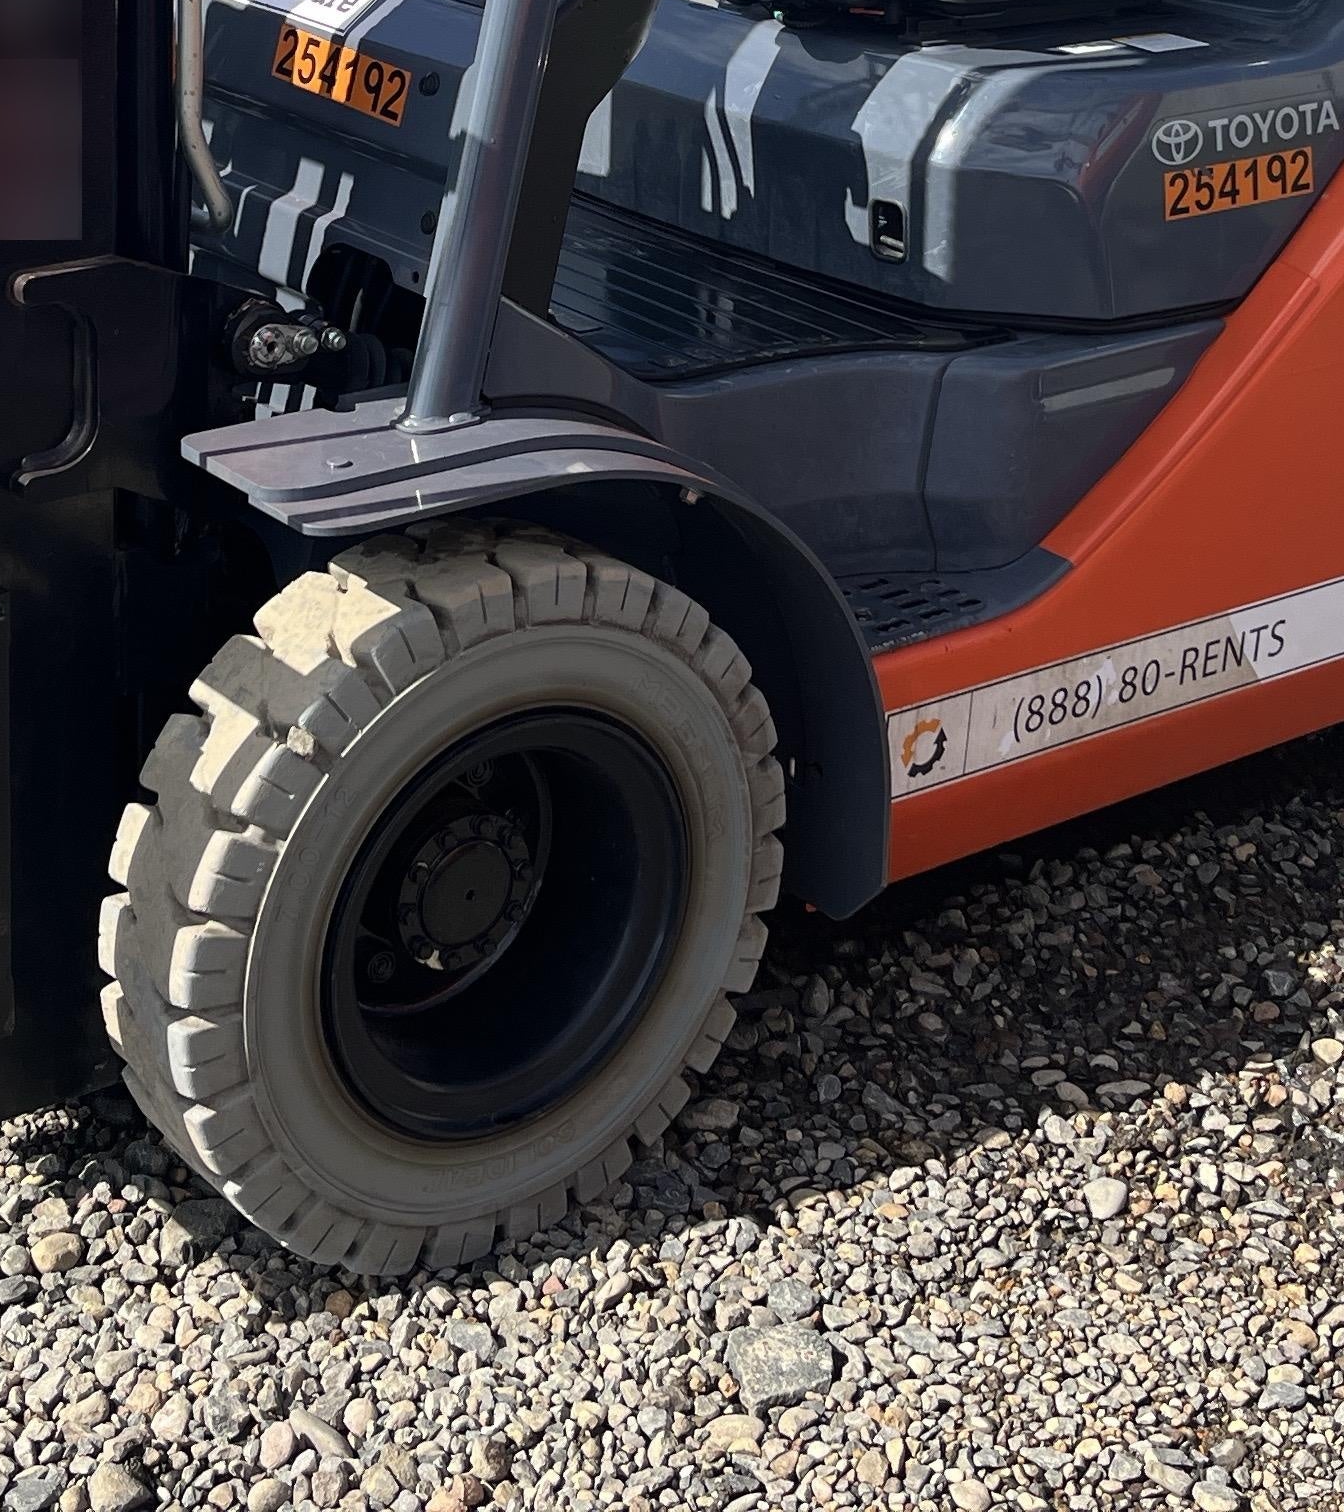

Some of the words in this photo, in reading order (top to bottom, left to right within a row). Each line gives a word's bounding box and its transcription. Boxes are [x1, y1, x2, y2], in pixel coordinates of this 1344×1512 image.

[275, 28, 408, 122] 254192
[1208, 100, 1340, 152] TOYOTA
[1168, 149, 1311, 217] 254192
[1012, 675, 1103, 743] (888)
[1116, 619, 1287, 703] 80-RENTS
